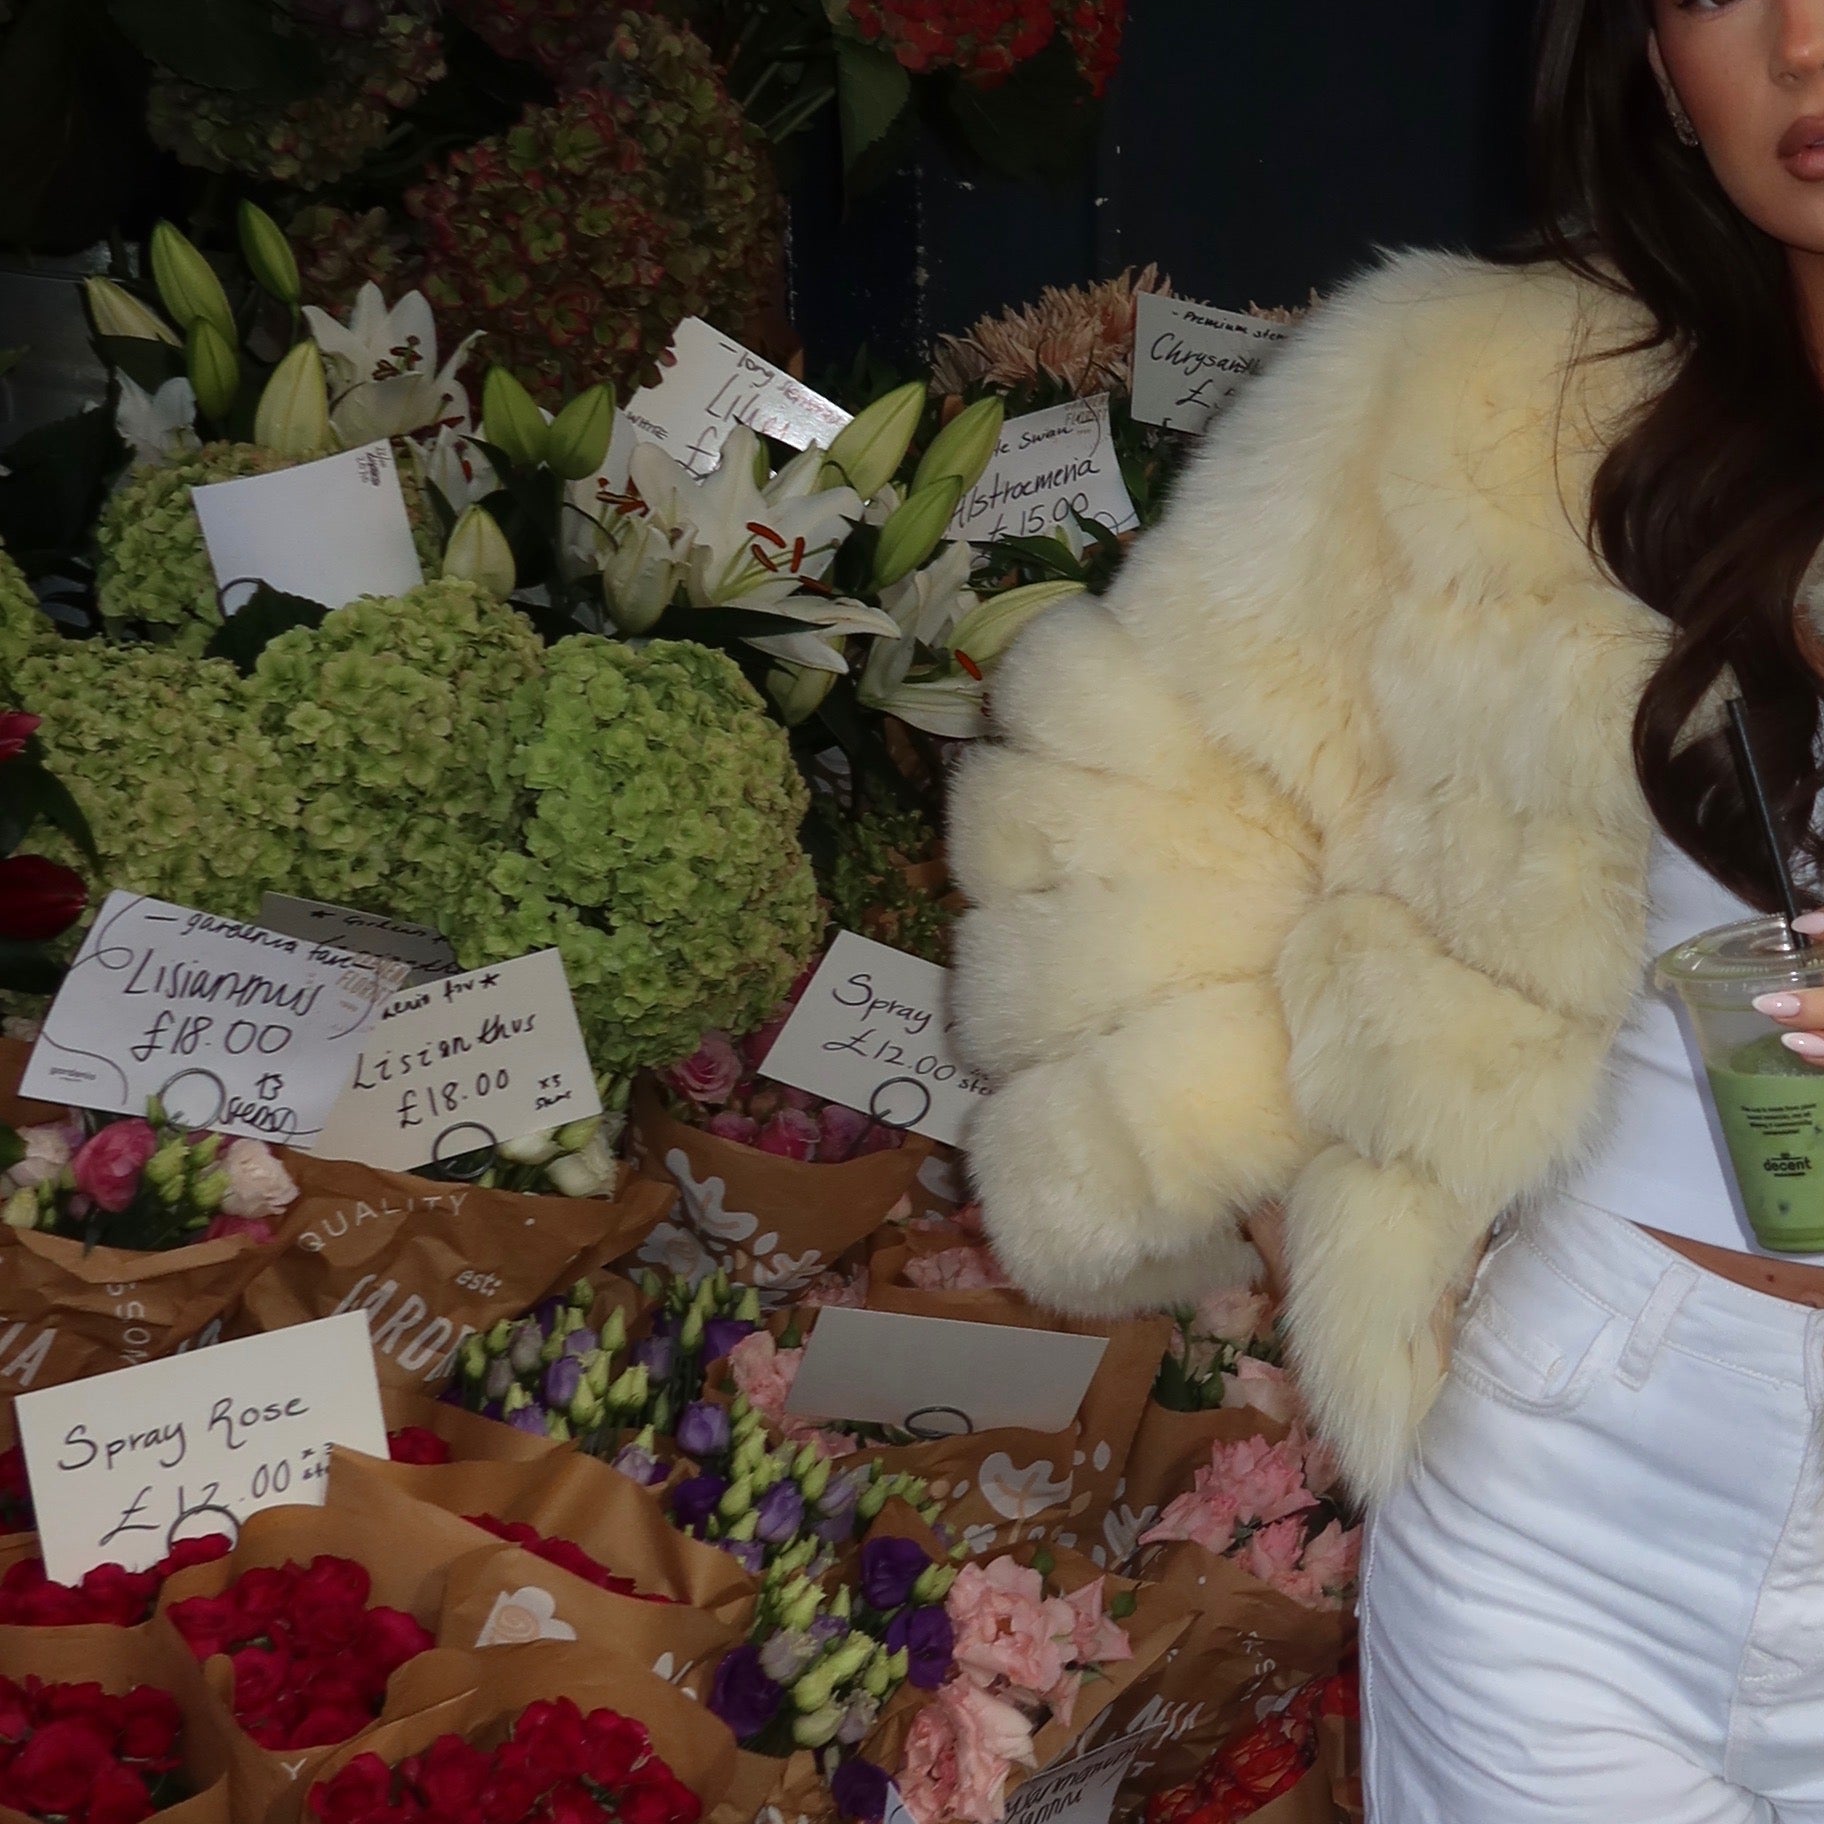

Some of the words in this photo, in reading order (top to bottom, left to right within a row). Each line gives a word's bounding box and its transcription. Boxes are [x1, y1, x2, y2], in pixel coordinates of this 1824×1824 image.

[624, 412, 668, 440] WHITE
[832, 973, 932, 1034] Spray
[130, 1009, 292, 1062] £18.00
[822, 1028, 956, 1081] £12.00
[397, 1068, 509, 1129] £18.00
[1763, 1156, 1812, 1172] decent
[300, 1192, 468, 1252] QUALITY
[455, 1270, 502, 1298] est:
[57, 1423, 185, 1471] Spray
[208, 1395, 309, 1450] Rose
[98, 1460, 292, 1547] £12.00
